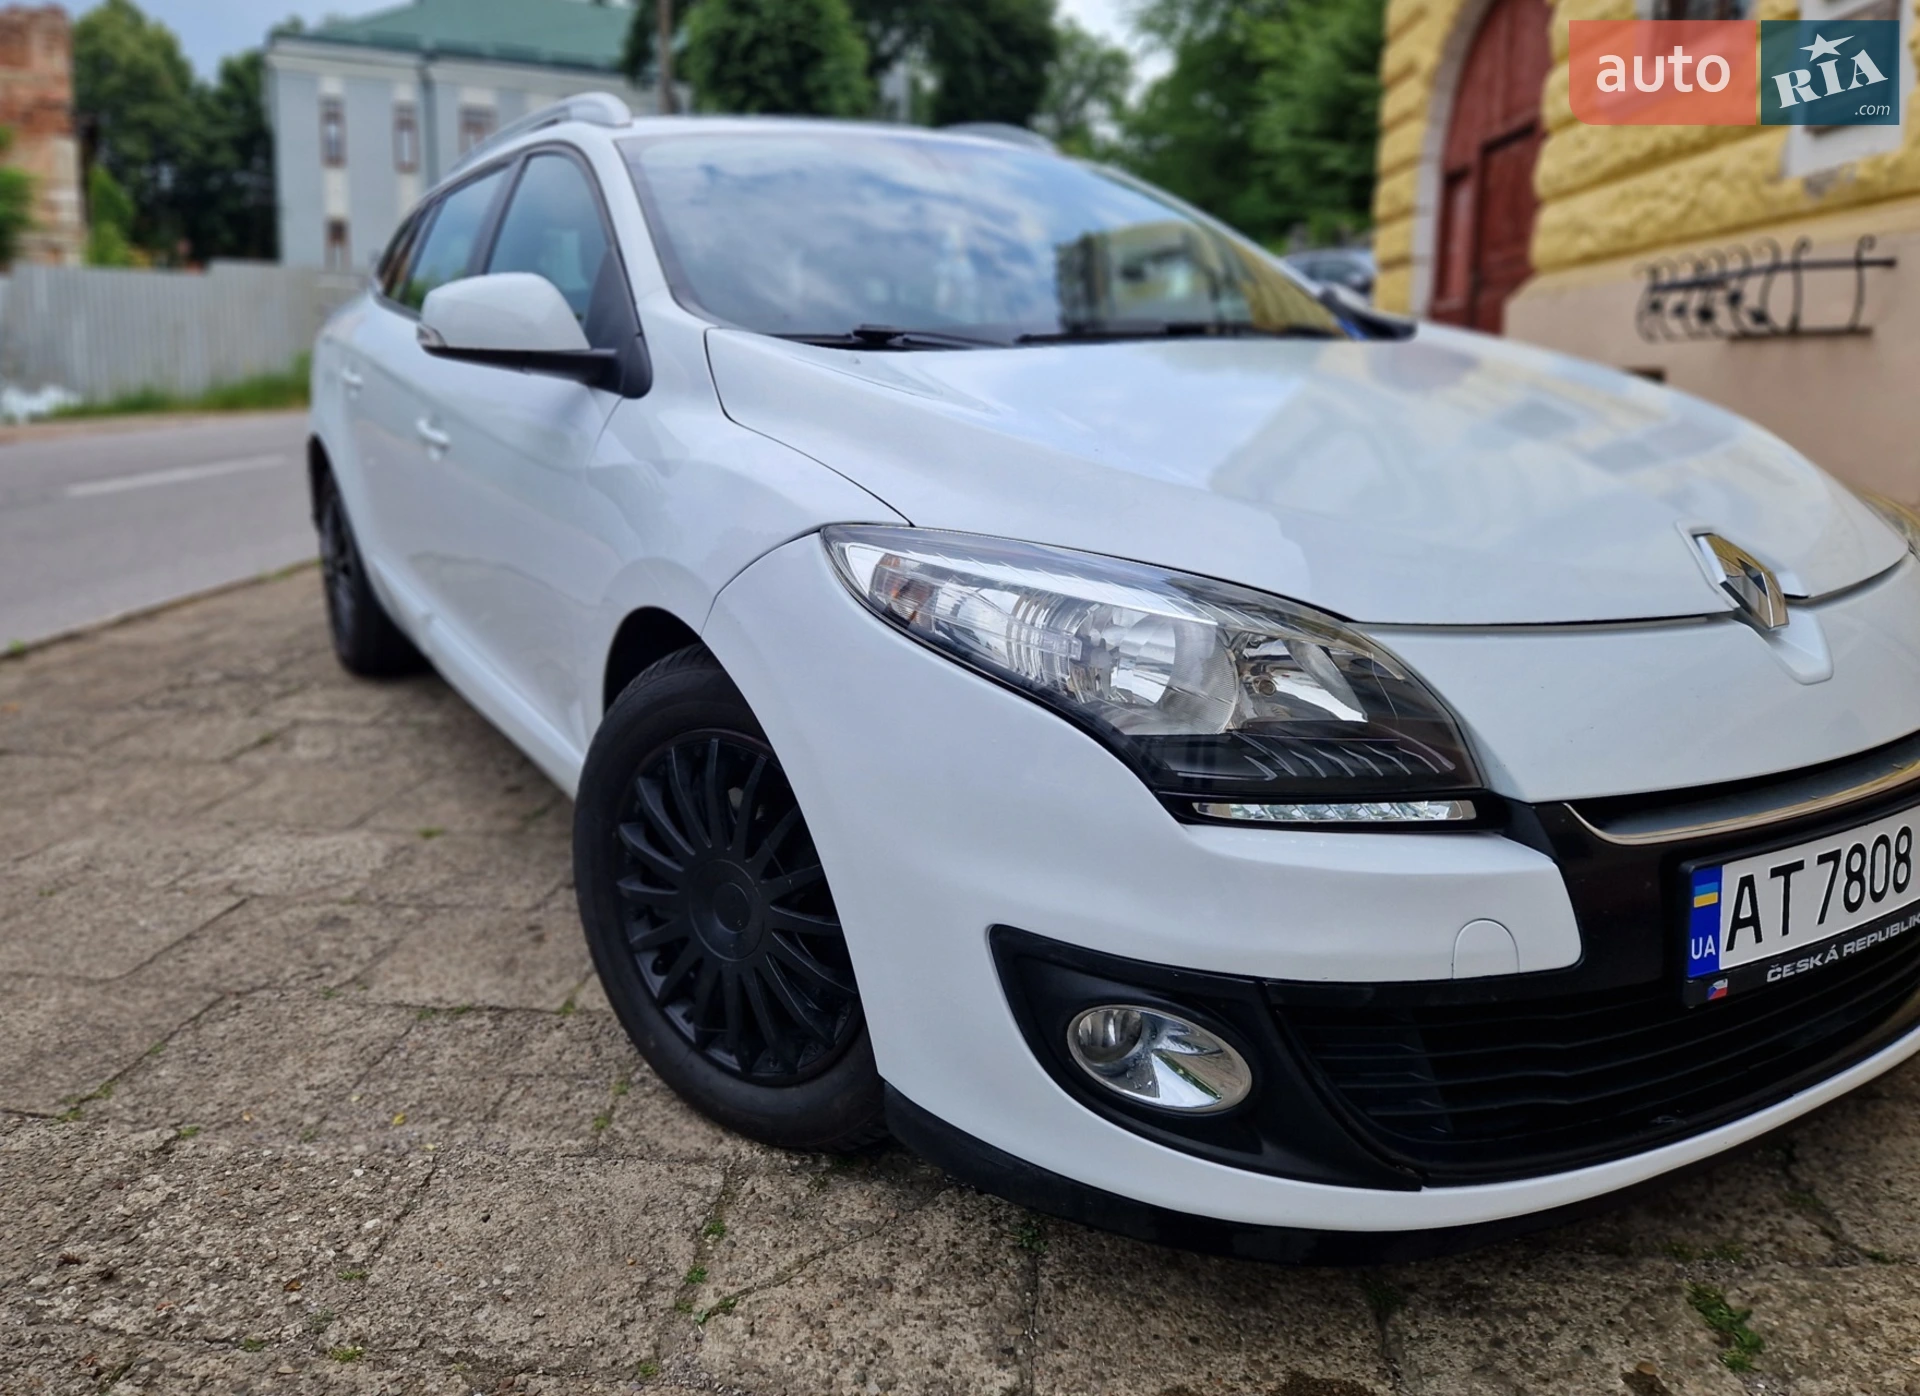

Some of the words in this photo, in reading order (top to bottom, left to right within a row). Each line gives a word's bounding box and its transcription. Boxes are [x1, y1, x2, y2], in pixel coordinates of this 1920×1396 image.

[1726, 859, 1805, 952] AT
[1816, 825, 1913, 926] 7808
[1691, 934, 1716, 960] UA
[1767, 943, 1839, 983] ČESKÁ
